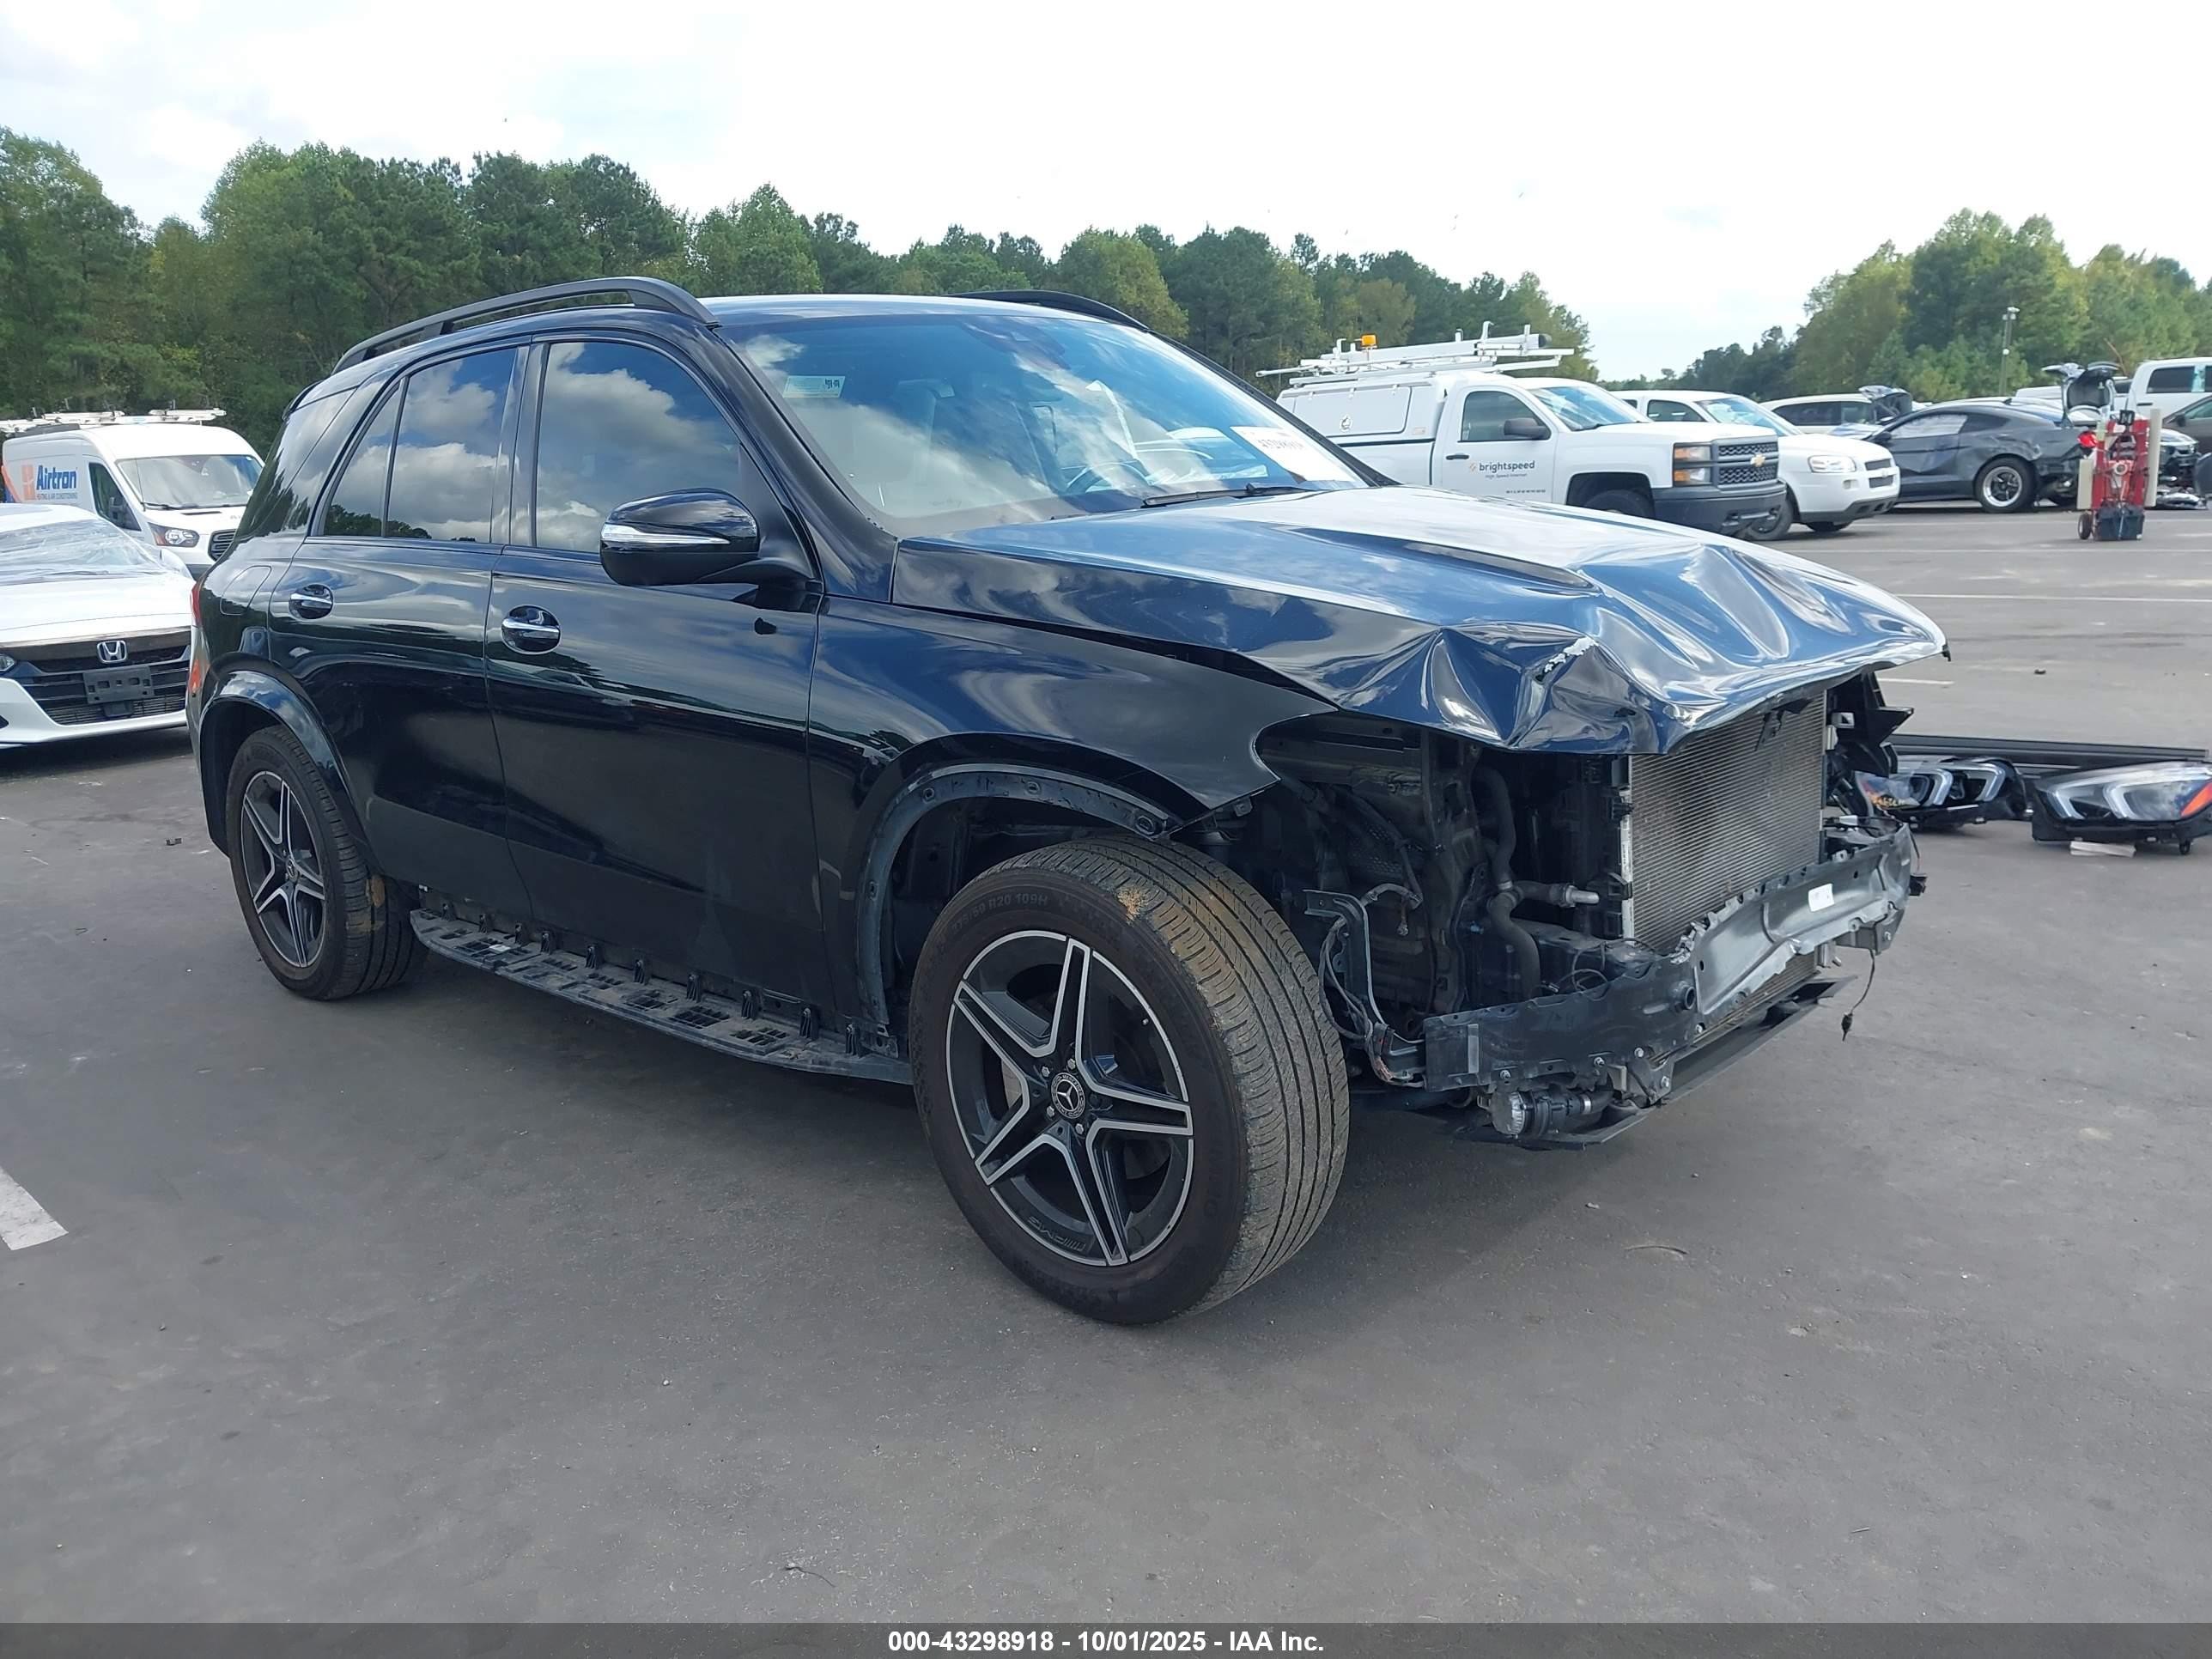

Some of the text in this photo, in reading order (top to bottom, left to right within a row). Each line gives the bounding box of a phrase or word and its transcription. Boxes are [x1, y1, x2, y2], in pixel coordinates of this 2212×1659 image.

[1479, 460, 1535, 473] brightspeed
[36, 465, 77, 490] Airtron
[1016, 892, 1048, 906] 109H
